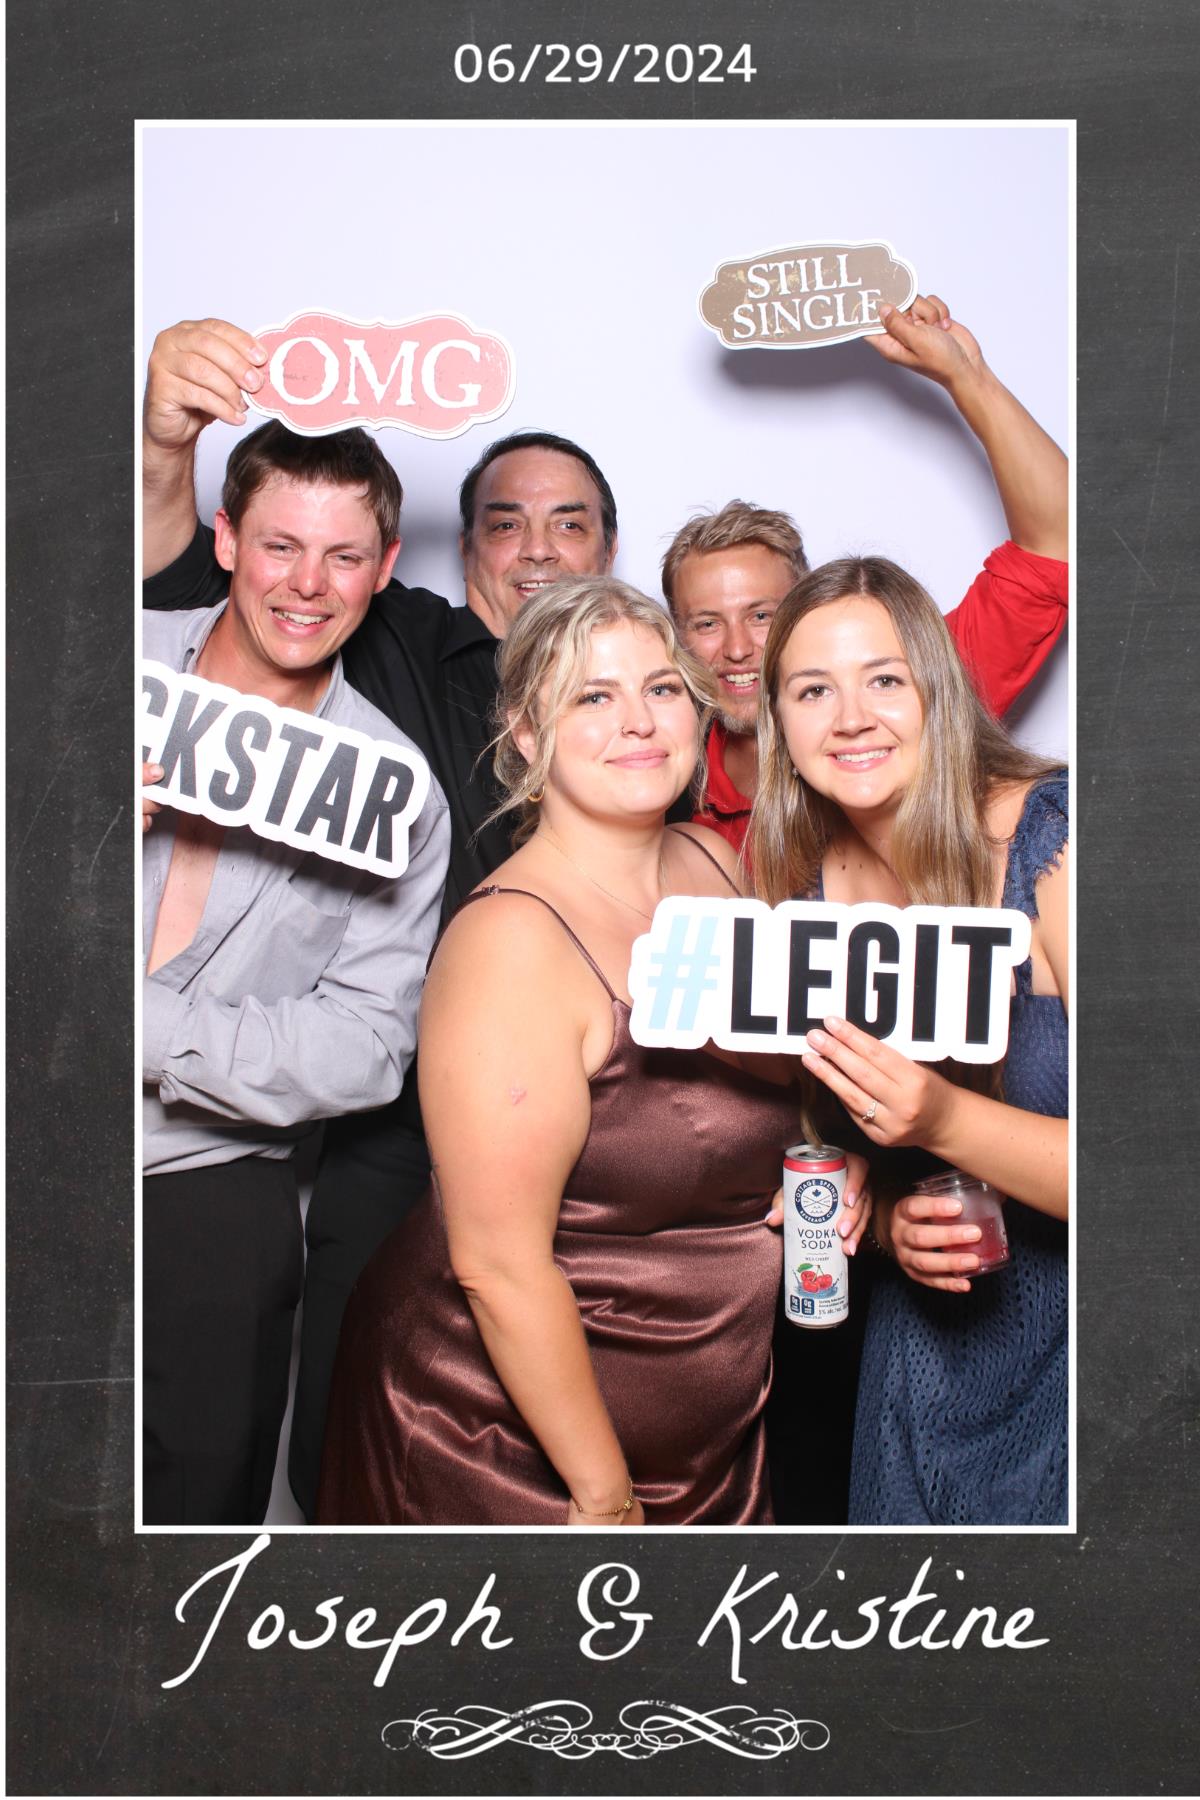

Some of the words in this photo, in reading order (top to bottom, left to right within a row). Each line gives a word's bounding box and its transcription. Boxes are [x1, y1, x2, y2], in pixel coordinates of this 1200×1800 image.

[746, 253, 862, 299] STILL
[732, 289, 881, 339] SINGLE
[269, 335, 483, 409] OMG
[647, 914, 1013, 1046] #LEGIT
[797, 1227, 836, 1239] VODKA
[801, 1239, 833, 1250] SODA
